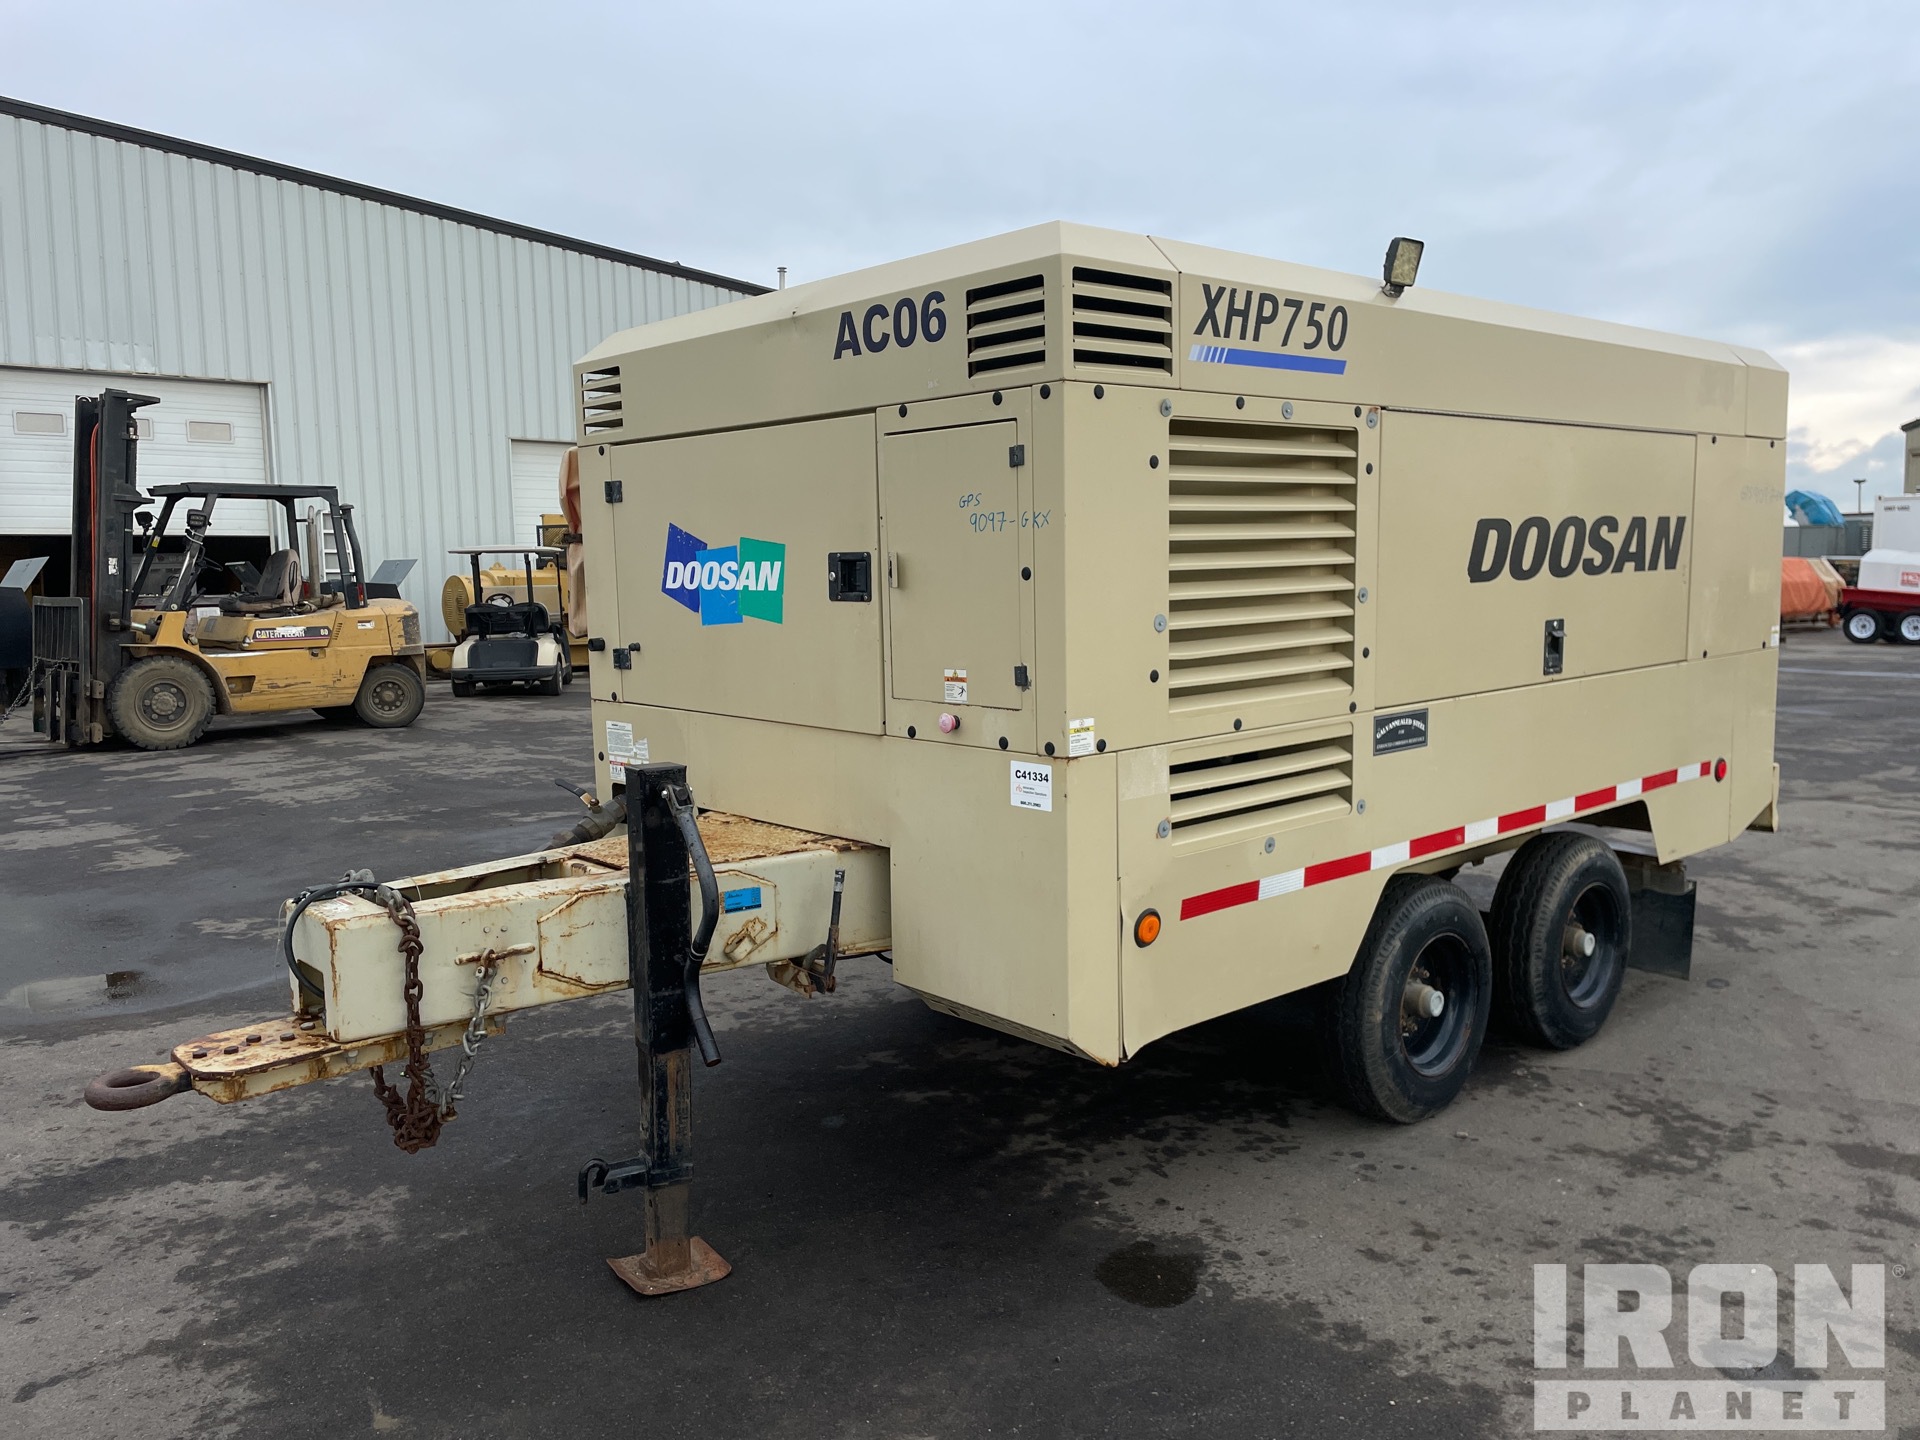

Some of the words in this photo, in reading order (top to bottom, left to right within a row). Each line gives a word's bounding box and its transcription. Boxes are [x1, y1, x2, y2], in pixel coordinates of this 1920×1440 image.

[833, 290, 947, 360] AC06
[1193, 283, 1349, 352] XHP750
[959, 493, 982, 508] GPS
[1467, 515, 1686, 583] DOOSAN
[665, 560, 782, 592] DOOSAN
[1015, 769, 1049, 783] C41334
